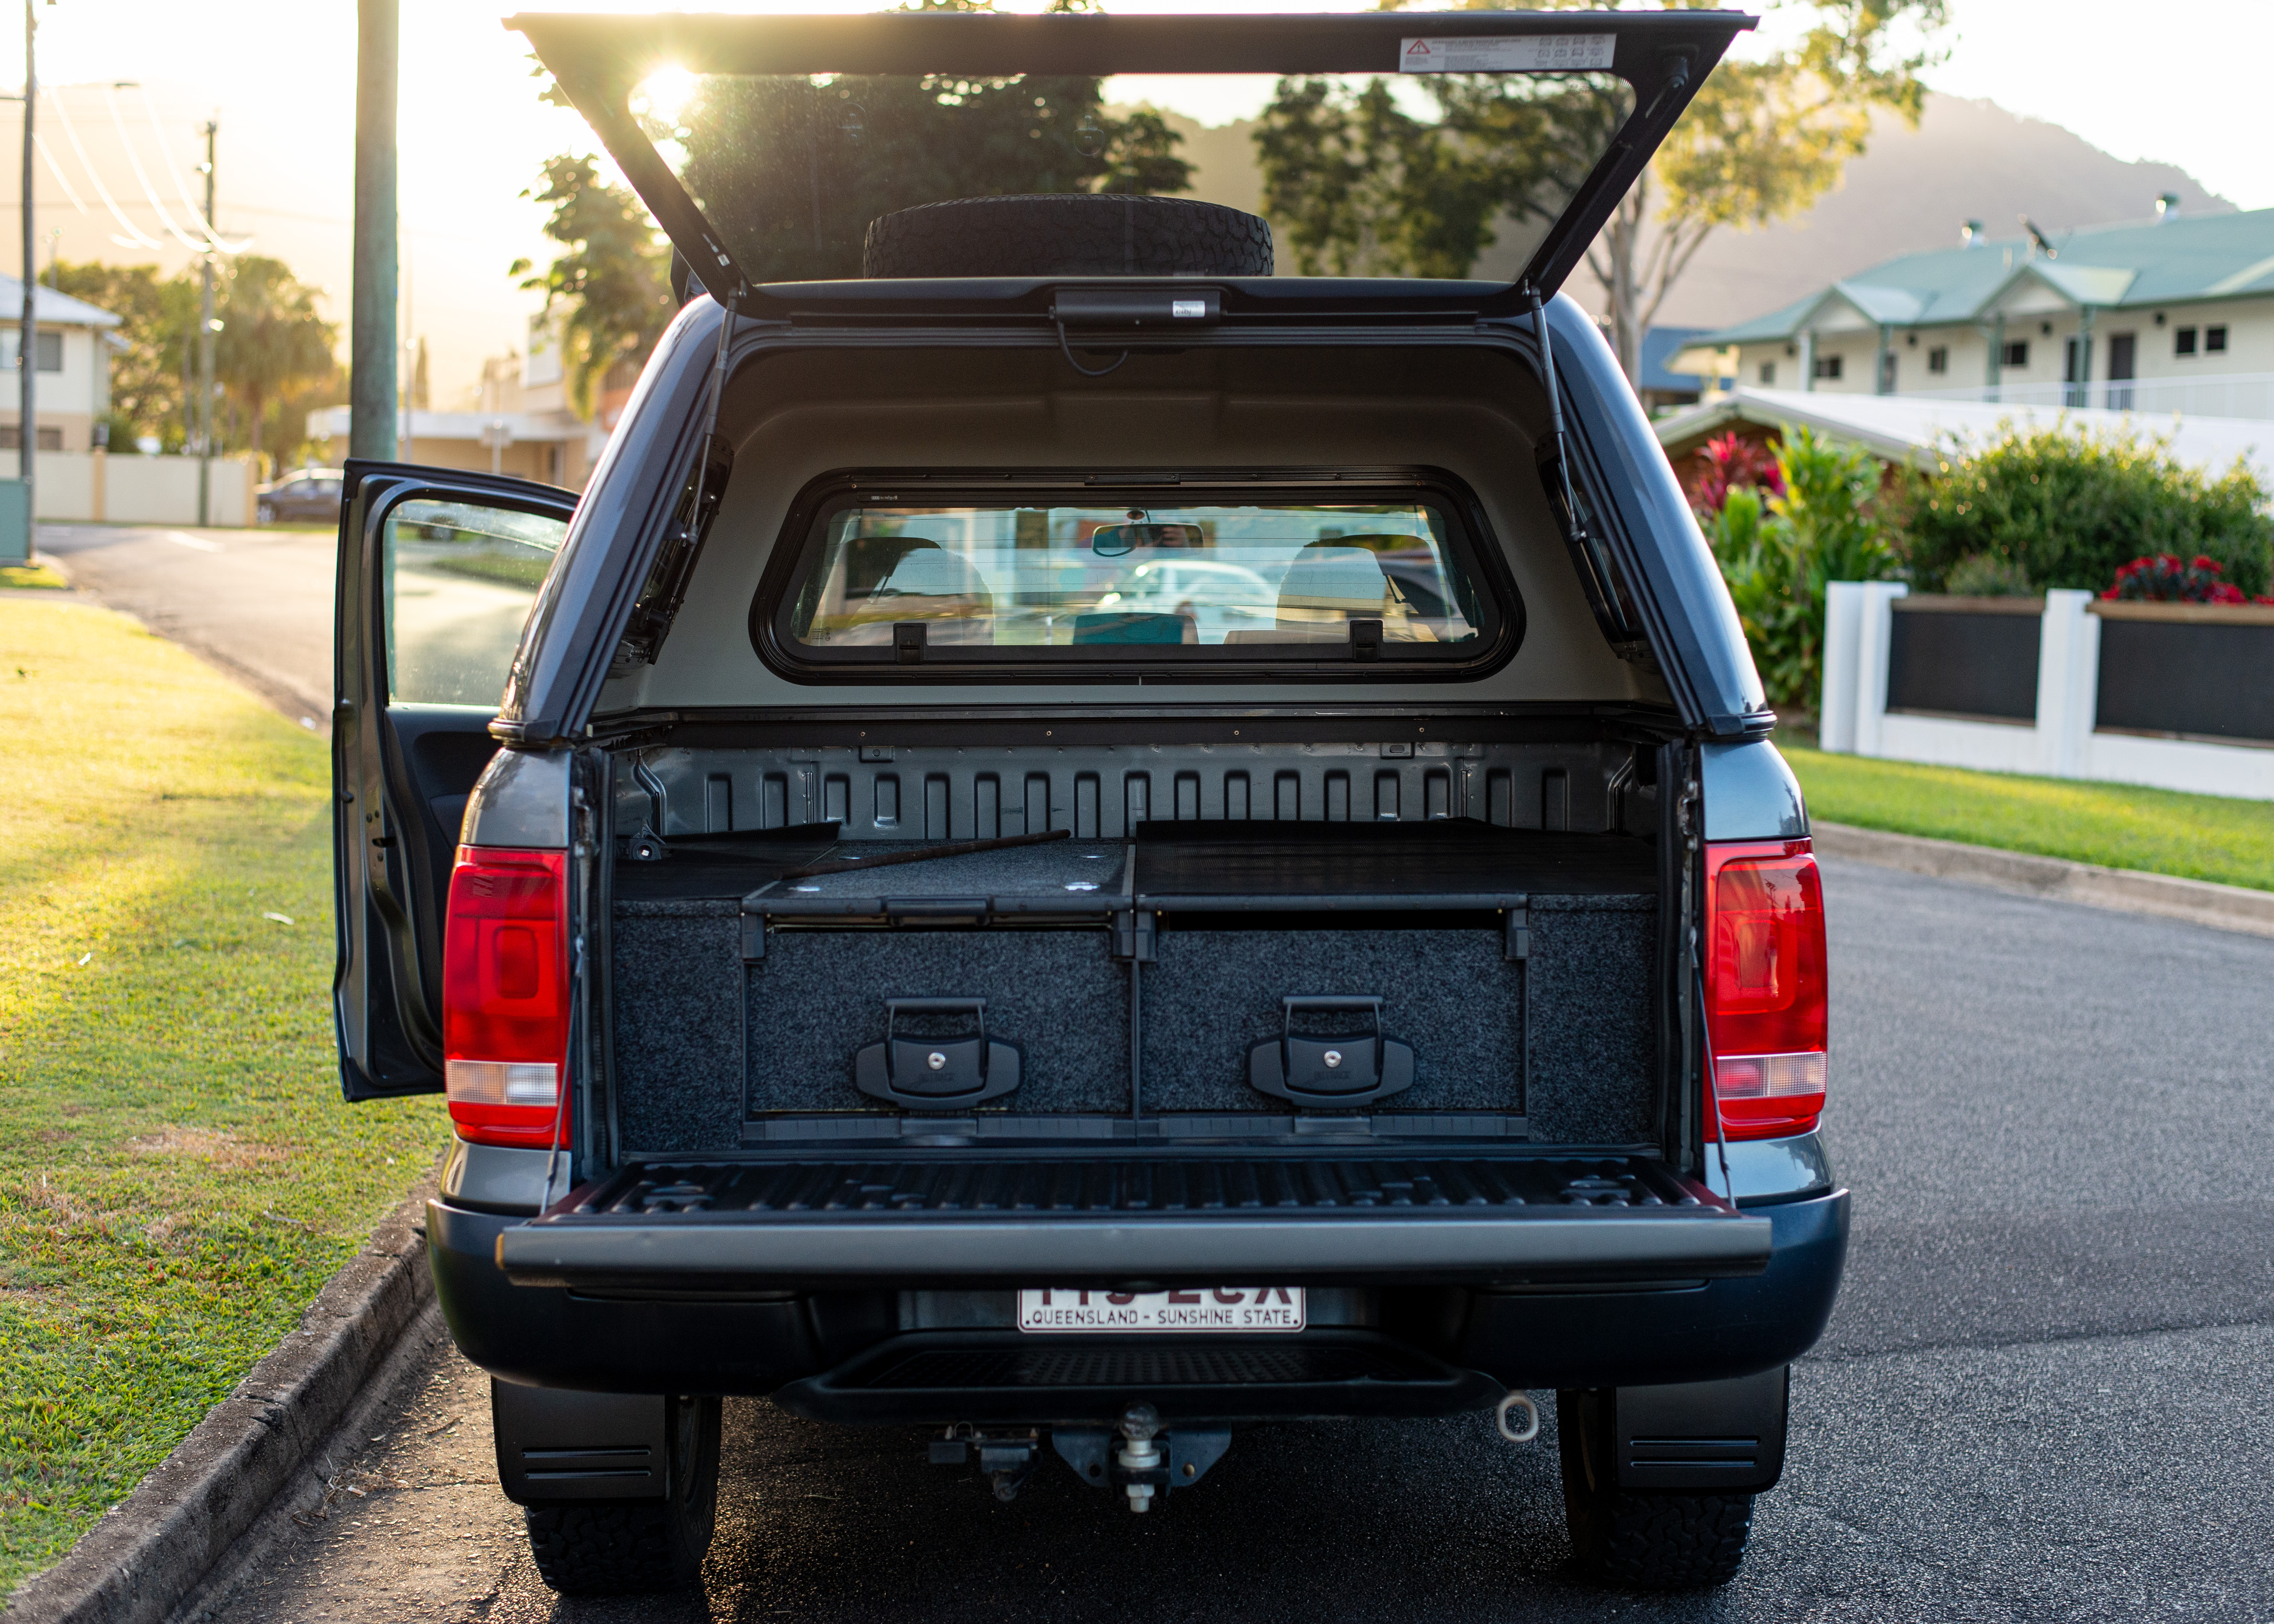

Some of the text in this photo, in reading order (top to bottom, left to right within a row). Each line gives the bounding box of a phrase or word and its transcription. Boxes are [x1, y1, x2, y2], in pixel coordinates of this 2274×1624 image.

[1033, 1310, 1138, 1324] QUEENSLAND
[1158, 1310, 1233, 1324] SUNSHINE
[1244, 1310, 1291, 1324] STATE
